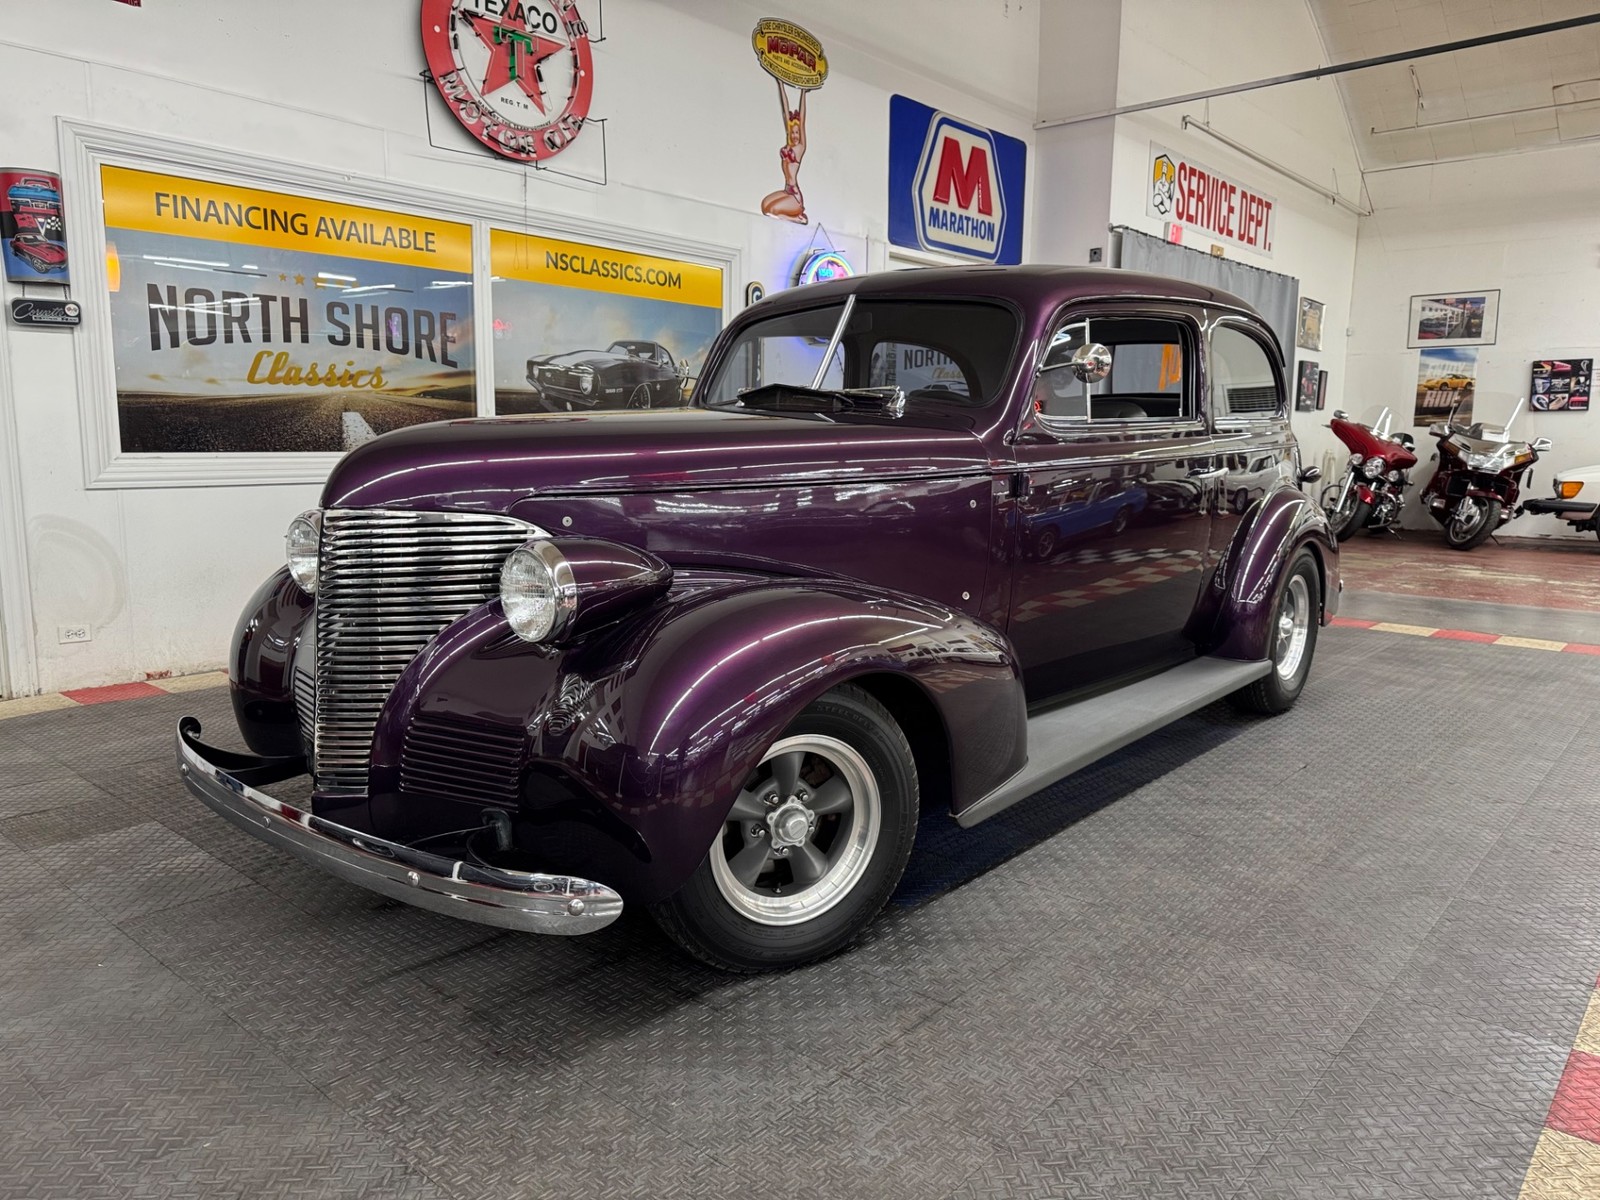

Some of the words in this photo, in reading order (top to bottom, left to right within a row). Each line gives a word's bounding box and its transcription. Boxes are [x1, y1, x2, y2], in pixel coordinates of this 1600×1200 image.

[439, 71, 537, 158] MOTOR
[932, 136, 993, 217] M
[1175, 161, 1237, 238] SERVICE
[1238, 189, 1273, 252] DEPT.
[154, 191, 309, 236] FINANCING
[314, 216, 437, 253] AVAILABLE
[929, 206, 996, 242] MARATHON
[545, 250, 682, 290] NSCLASSICS.COM
[146, 282, 310, 351] NORTH
[325, 300, 458, 369] SHORE
[246, 350, 389, 389] Classics
[1422, 390, 1461, 408] RIDE
